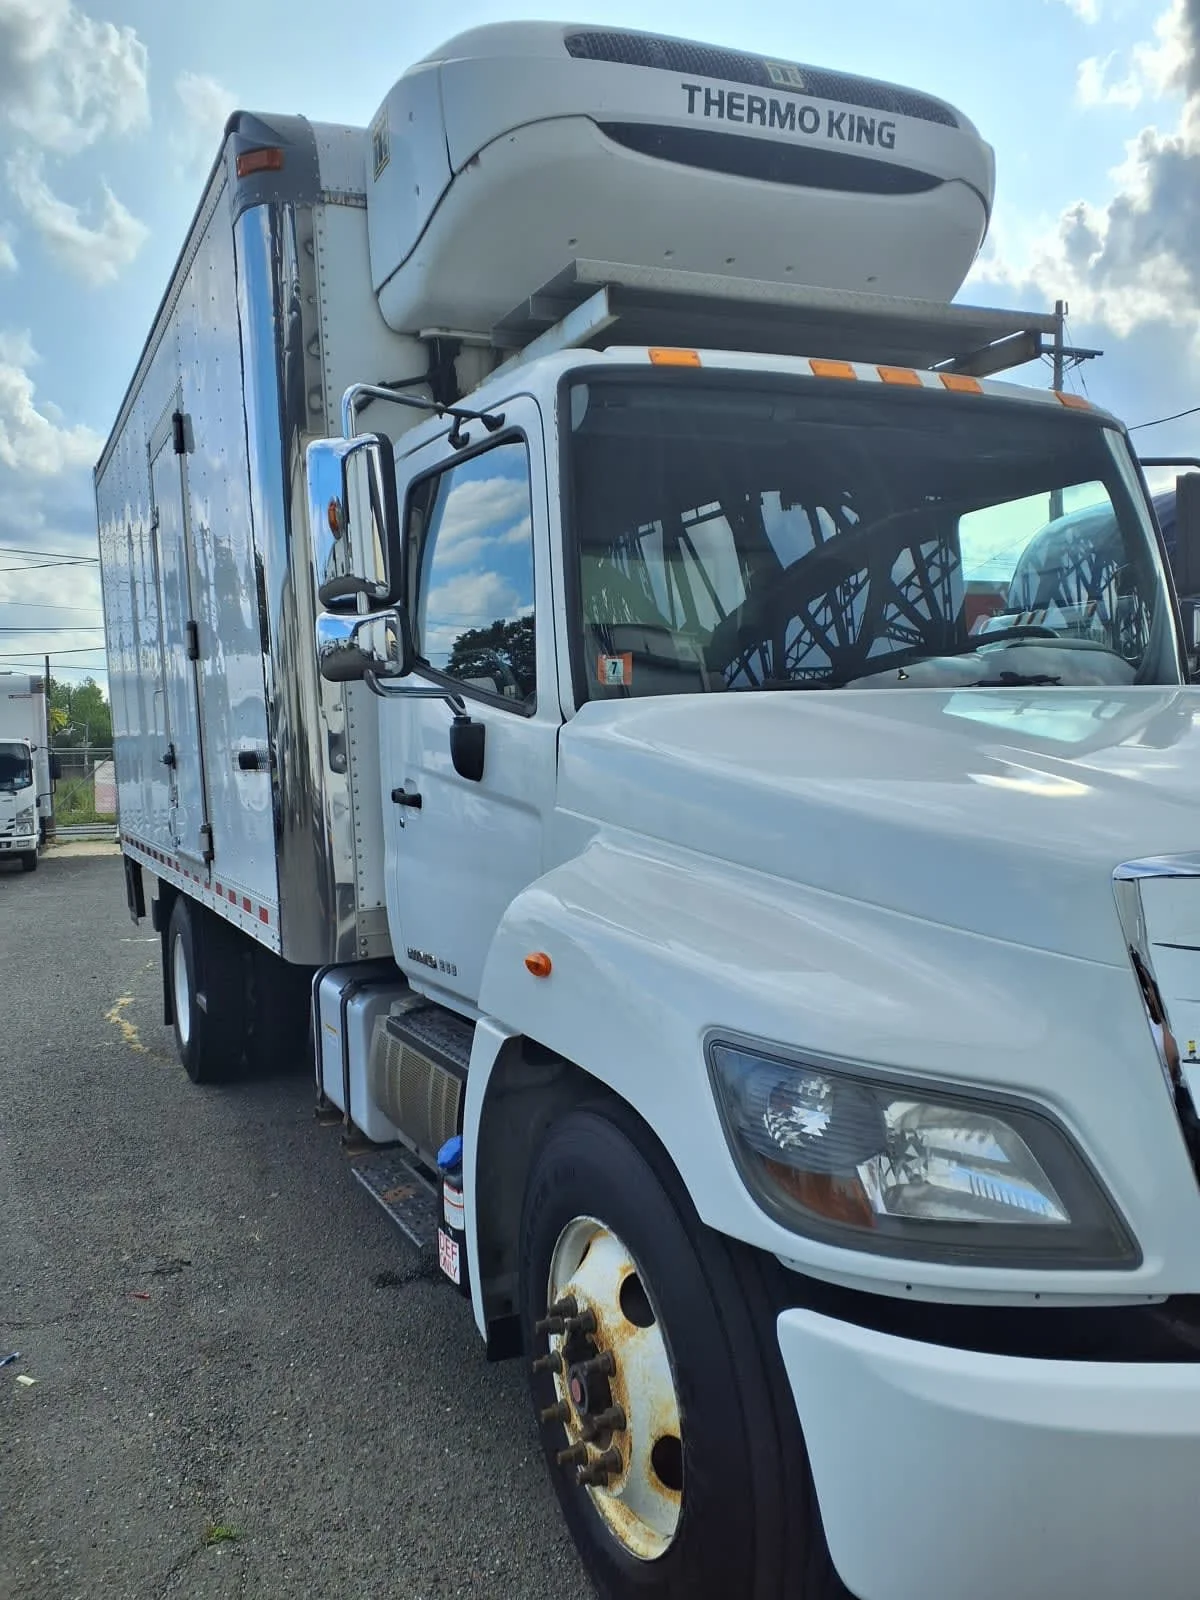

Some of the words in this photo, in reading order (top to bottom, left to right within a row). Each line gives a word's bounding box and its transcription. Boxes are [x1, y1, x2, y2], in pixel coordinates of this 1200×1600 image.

[681, 83, 821, 134] THERMO
[827, 110, 896, 149] KING
[611, 661, 618, 675] 7
[439, 1231, 458, 1262] DEF
